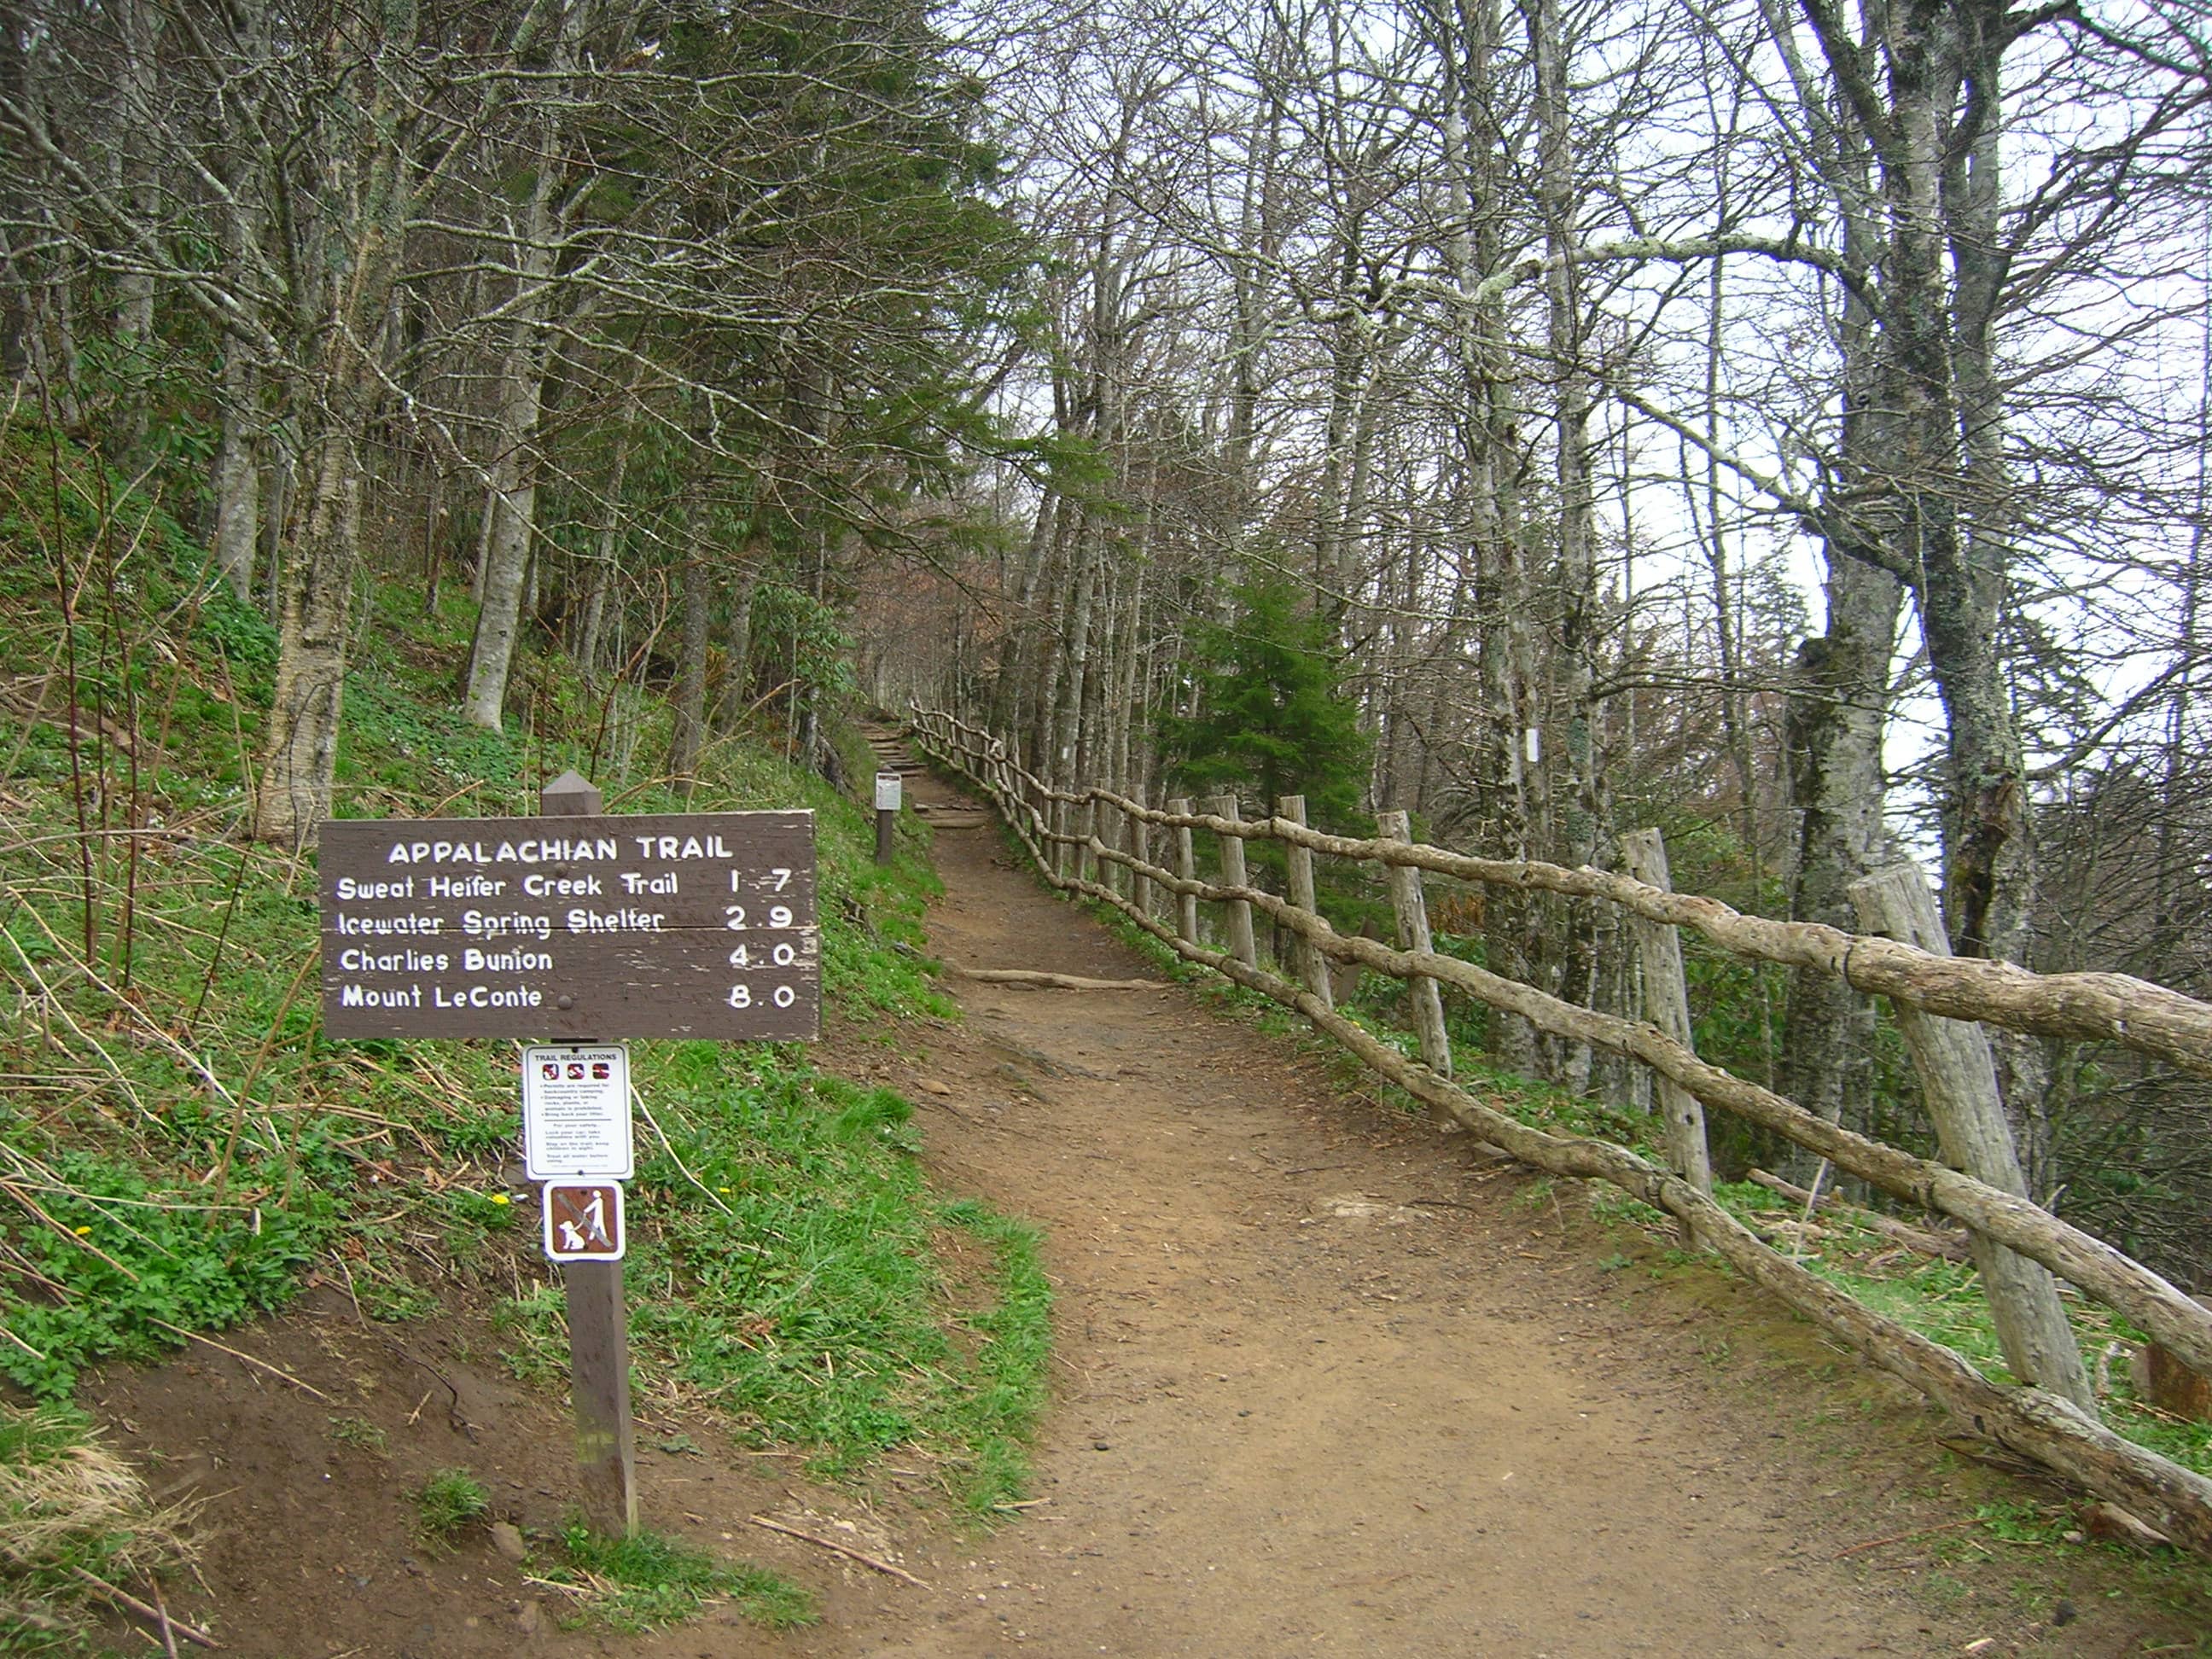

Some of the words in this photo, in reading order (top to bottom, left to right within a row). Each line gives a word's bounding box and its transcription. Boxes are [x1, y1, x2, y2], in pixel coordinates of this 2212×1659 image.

[388, 840, 617, 864] APPALACHIAN
[636, 835, 733, 859] TRAIL
[336, 876, 414, 899] Sweat
[430, 876, 506, 897] Heifer
[523, 875, 602, 896] Creek
[620, 872, 678, 894] Trail
[338, 912, 445, 935] Icewater
[463, 910, 550, 940] Spring
[567, 907, 665, 933] Shelter
[726, 905, 793, 930] 2.9
[341, 949, 449, 971] Charlies
[464, 948, 553, 971] Bunion
[730, 943, 795, 966] 4.0
[342, 984, 422, 1007] Mount
[435, 985, 542, 1007] LeConte
[731, 984, 795, 1008] 8.0
